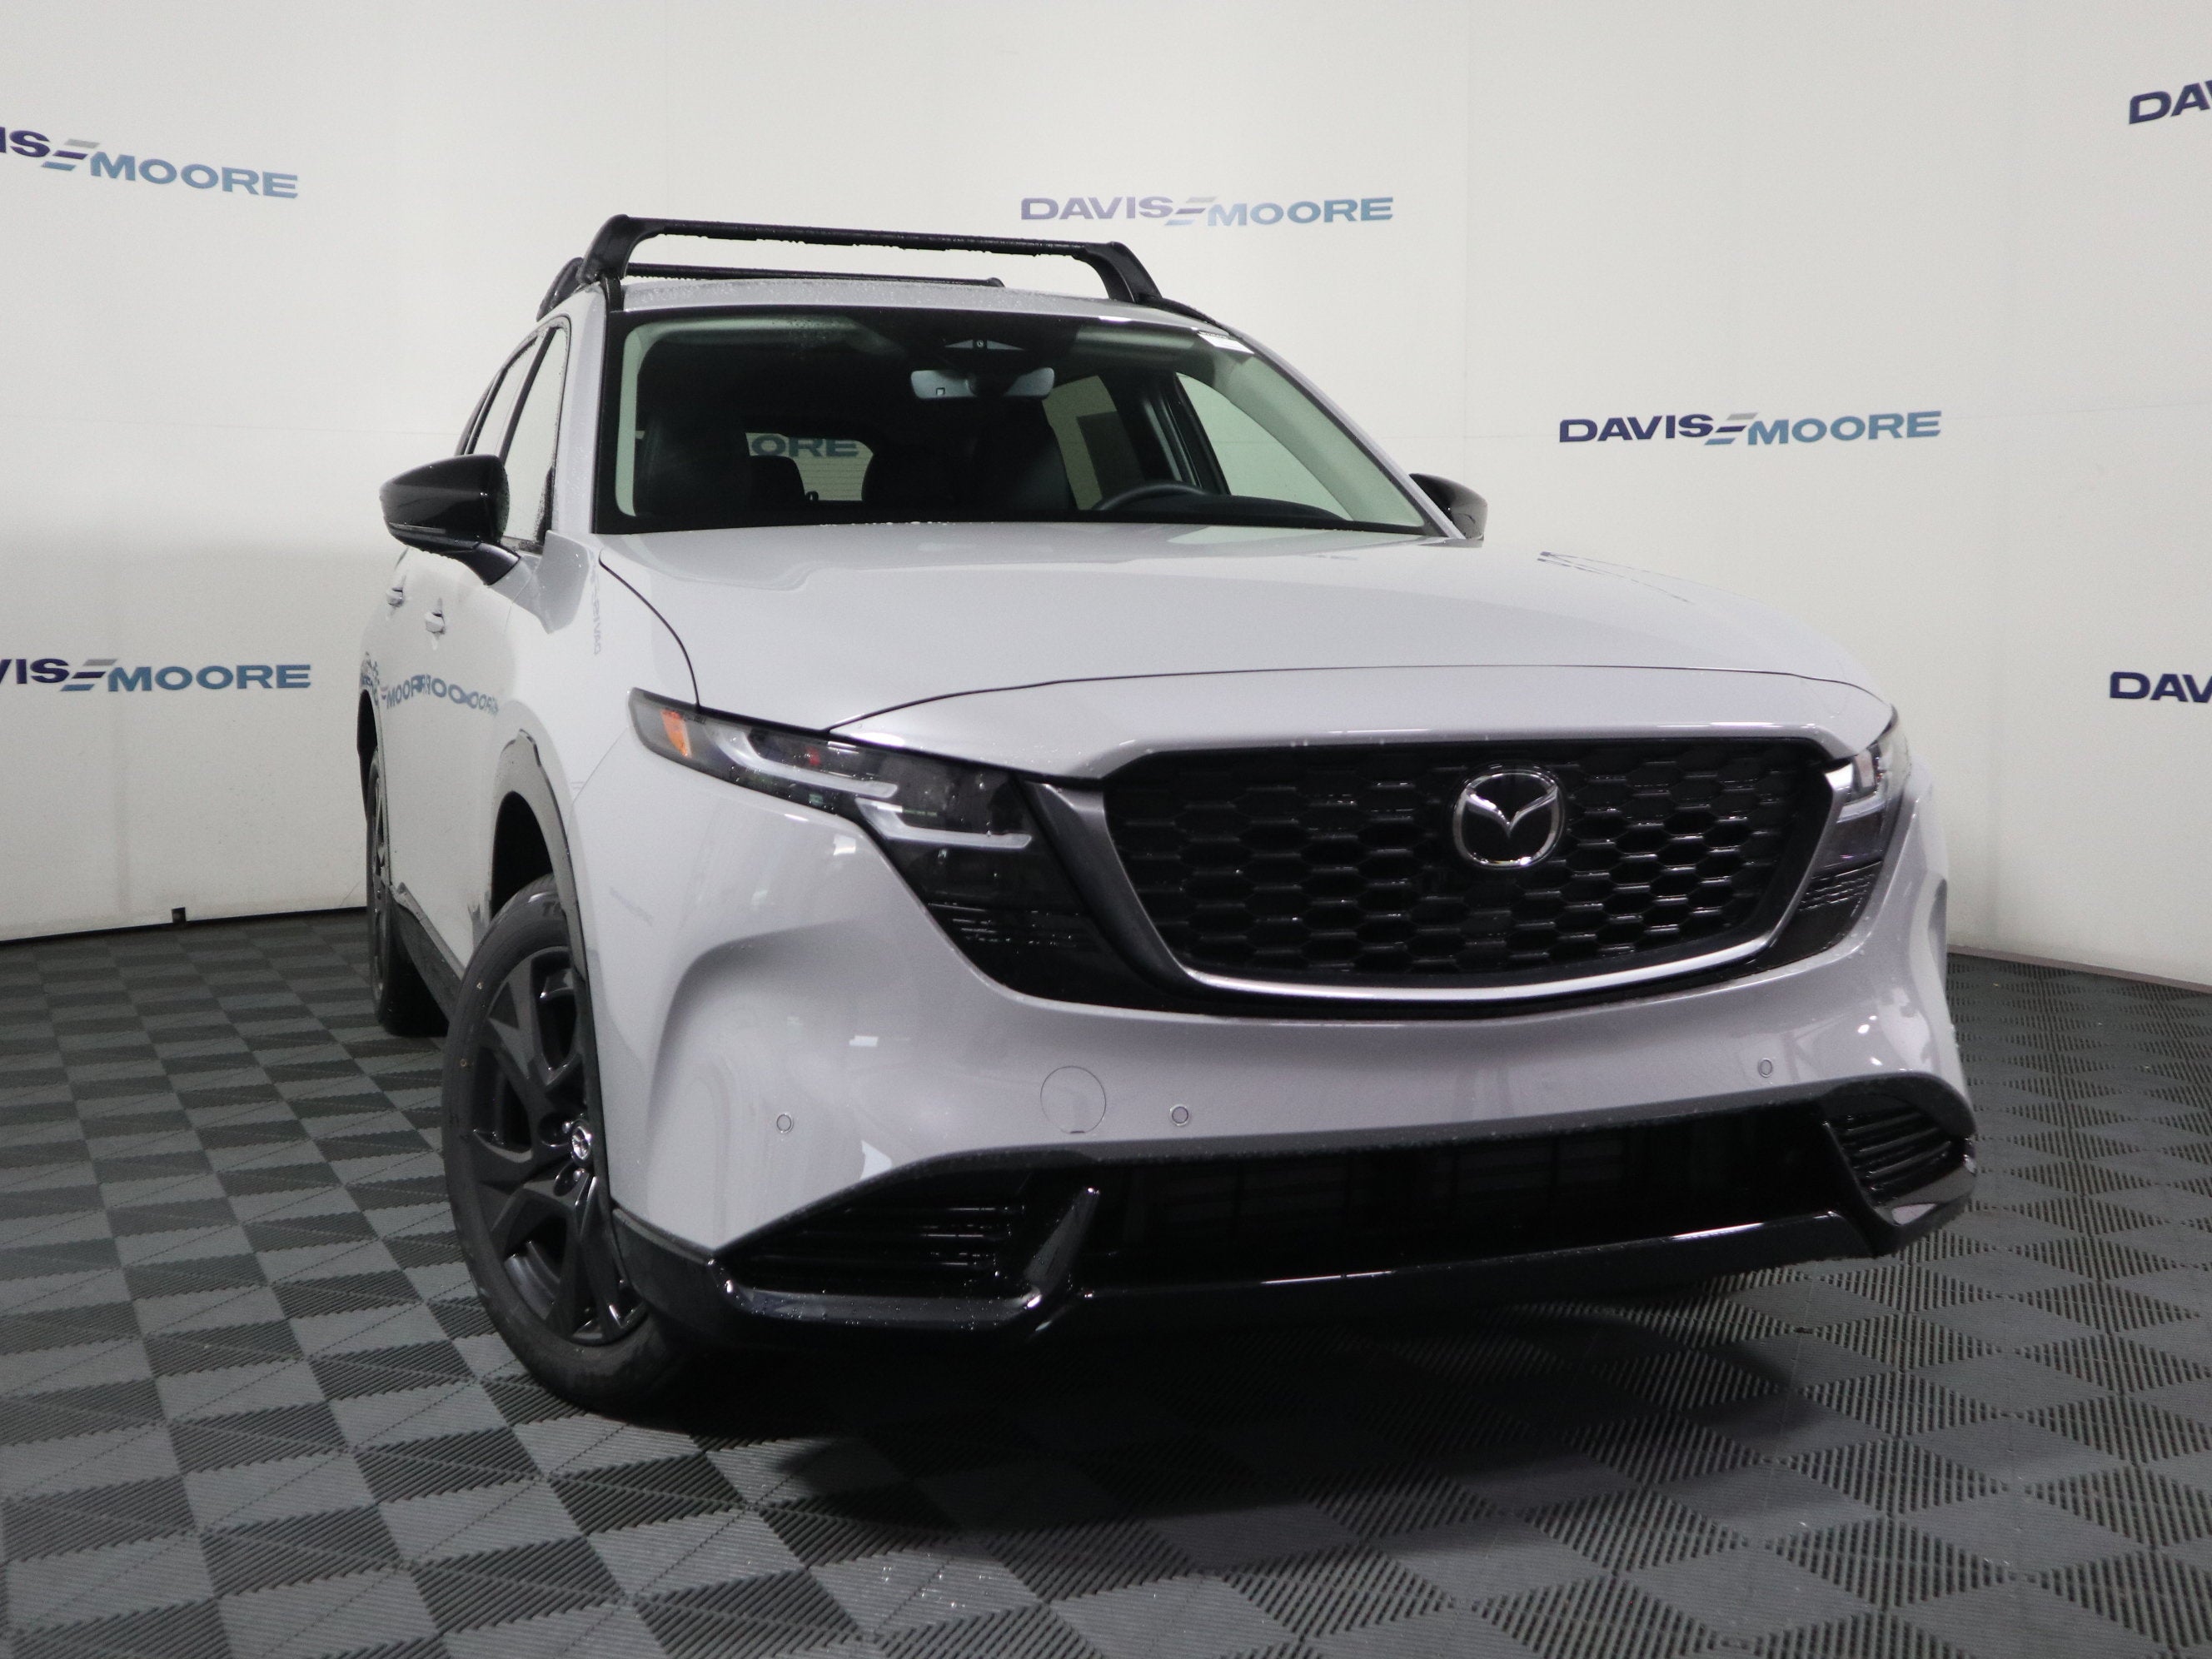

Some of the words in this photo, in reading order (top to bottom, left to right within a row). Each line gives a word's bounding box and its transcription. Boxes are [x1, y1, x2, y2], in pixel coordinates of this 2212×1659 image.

[89, 151, 299, 200] MOORE
[1020, 196, 1173, 221] DAVIS
[1207, 197, 1394, 227] MOORE
[1559, 413, 1714, 443] DAVIS
[1747, 411, 1942, 446] MOORE
[751, 434, 859, 457] ORE
[107, 664, 311, 692] MOORE
